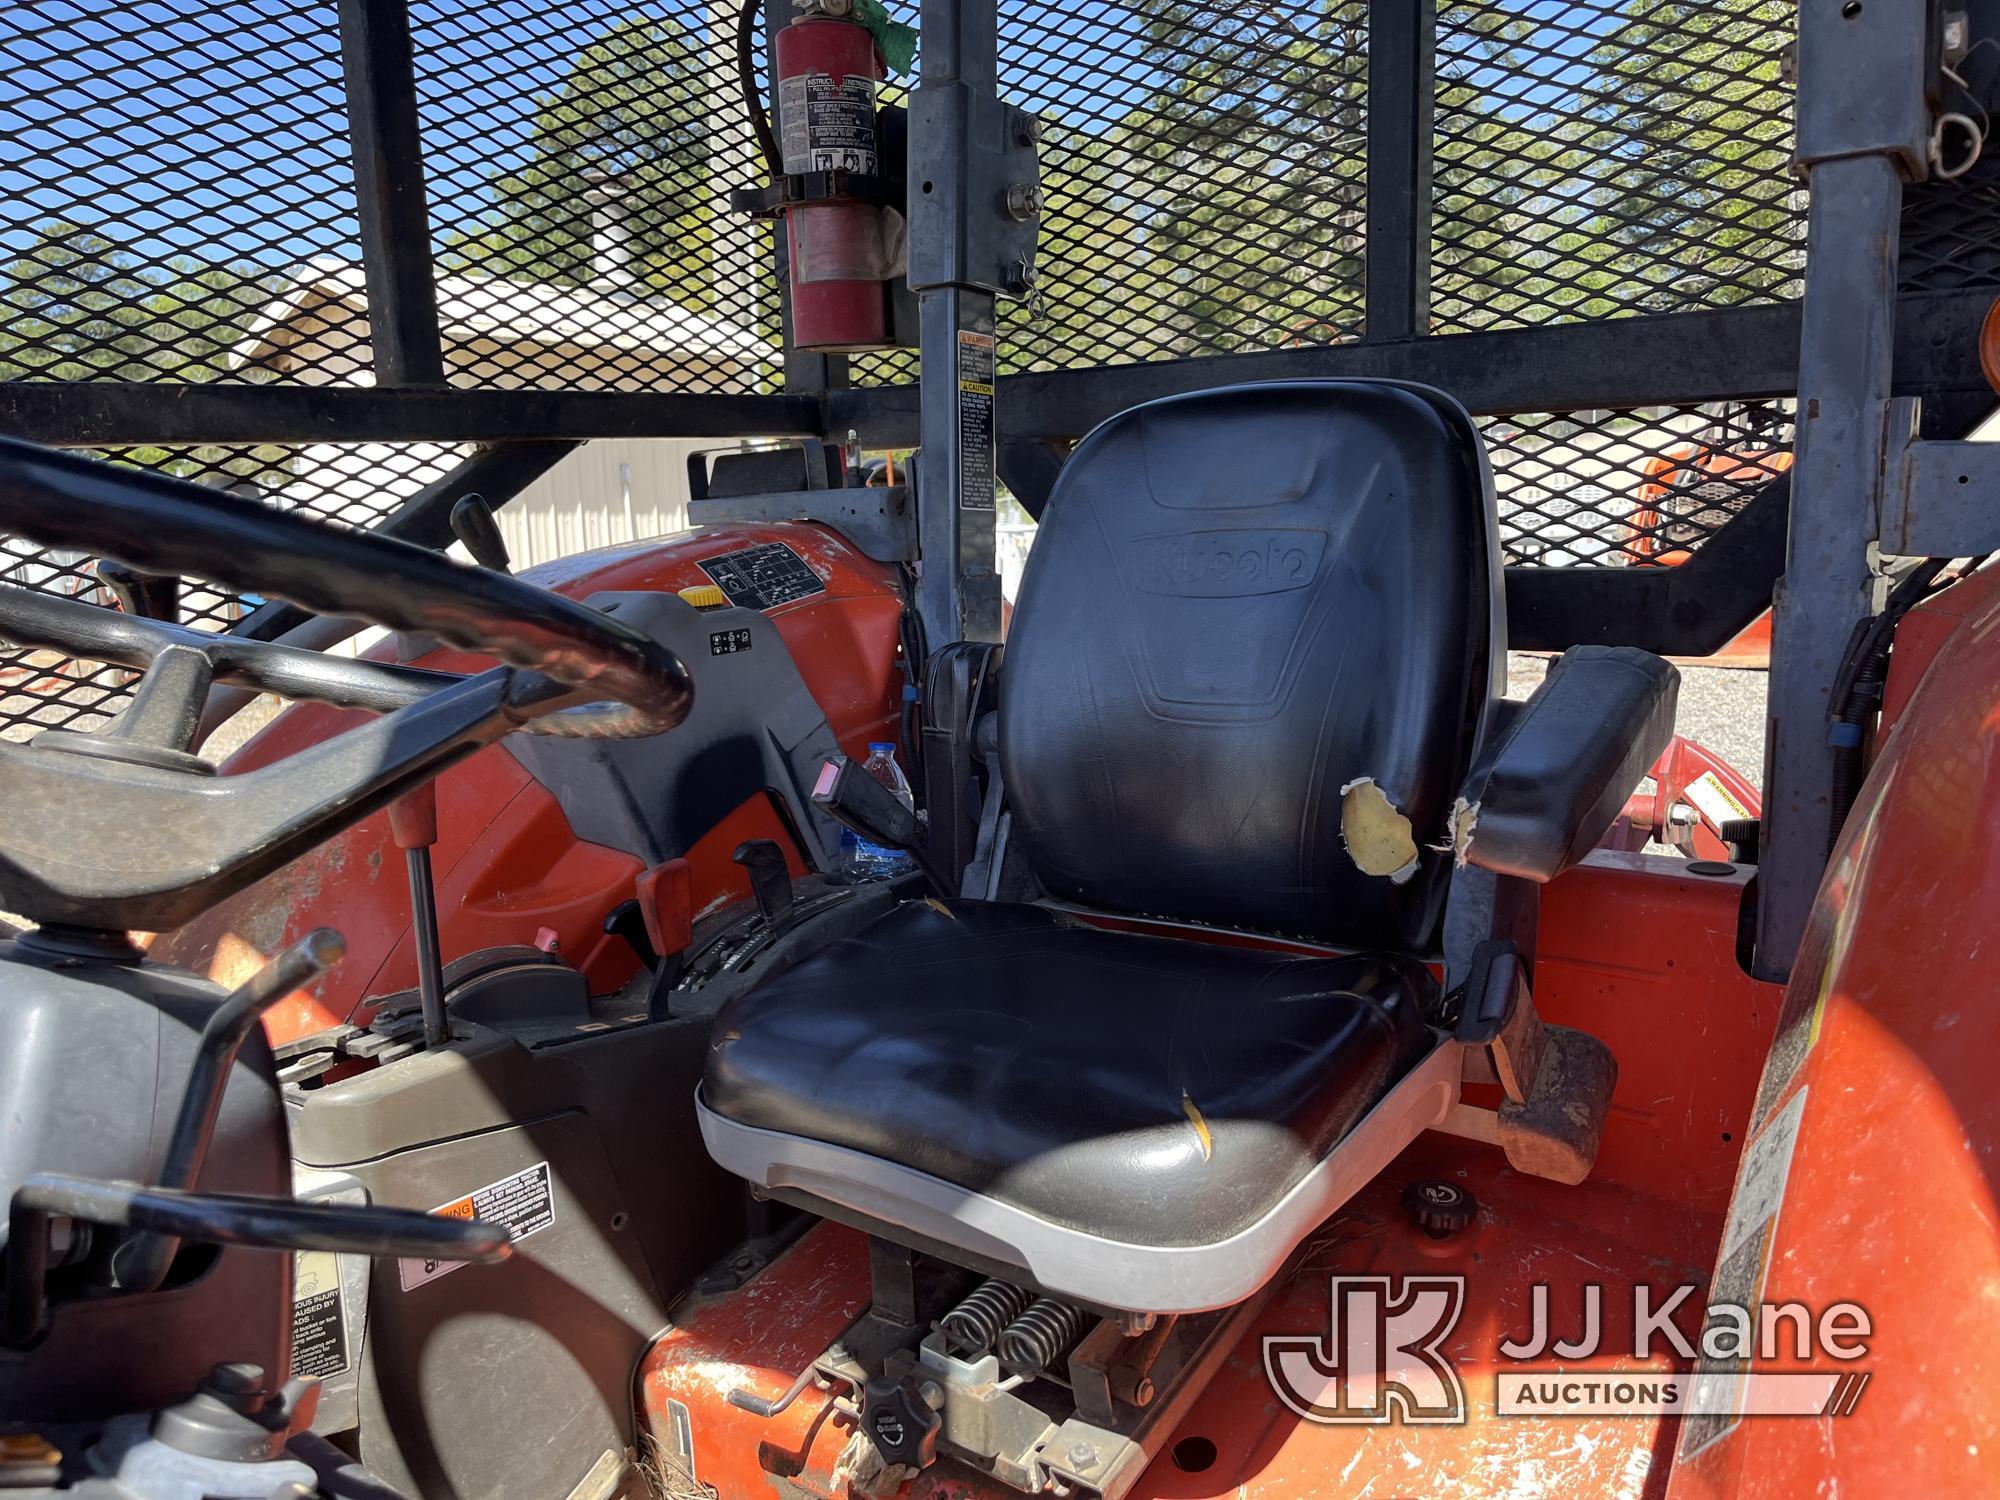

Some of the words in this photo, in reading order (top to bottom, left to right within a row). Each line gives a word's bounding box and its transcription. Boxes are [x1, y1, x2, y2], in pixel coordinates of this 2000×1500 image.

[968, 384, 992, 393] CAUTION
[294, 1298, 312, 1309] IOUS
[313, 1289, 339, 1303] INJURY
[295, 1304, 323, 1318] AUSED
[324, 1299, 335, 1308] BY
[294, 1316, 310, 1325] ADS
[299, 1322, 318, 1331] bucket
[325, 1338, 337, 1346] and
